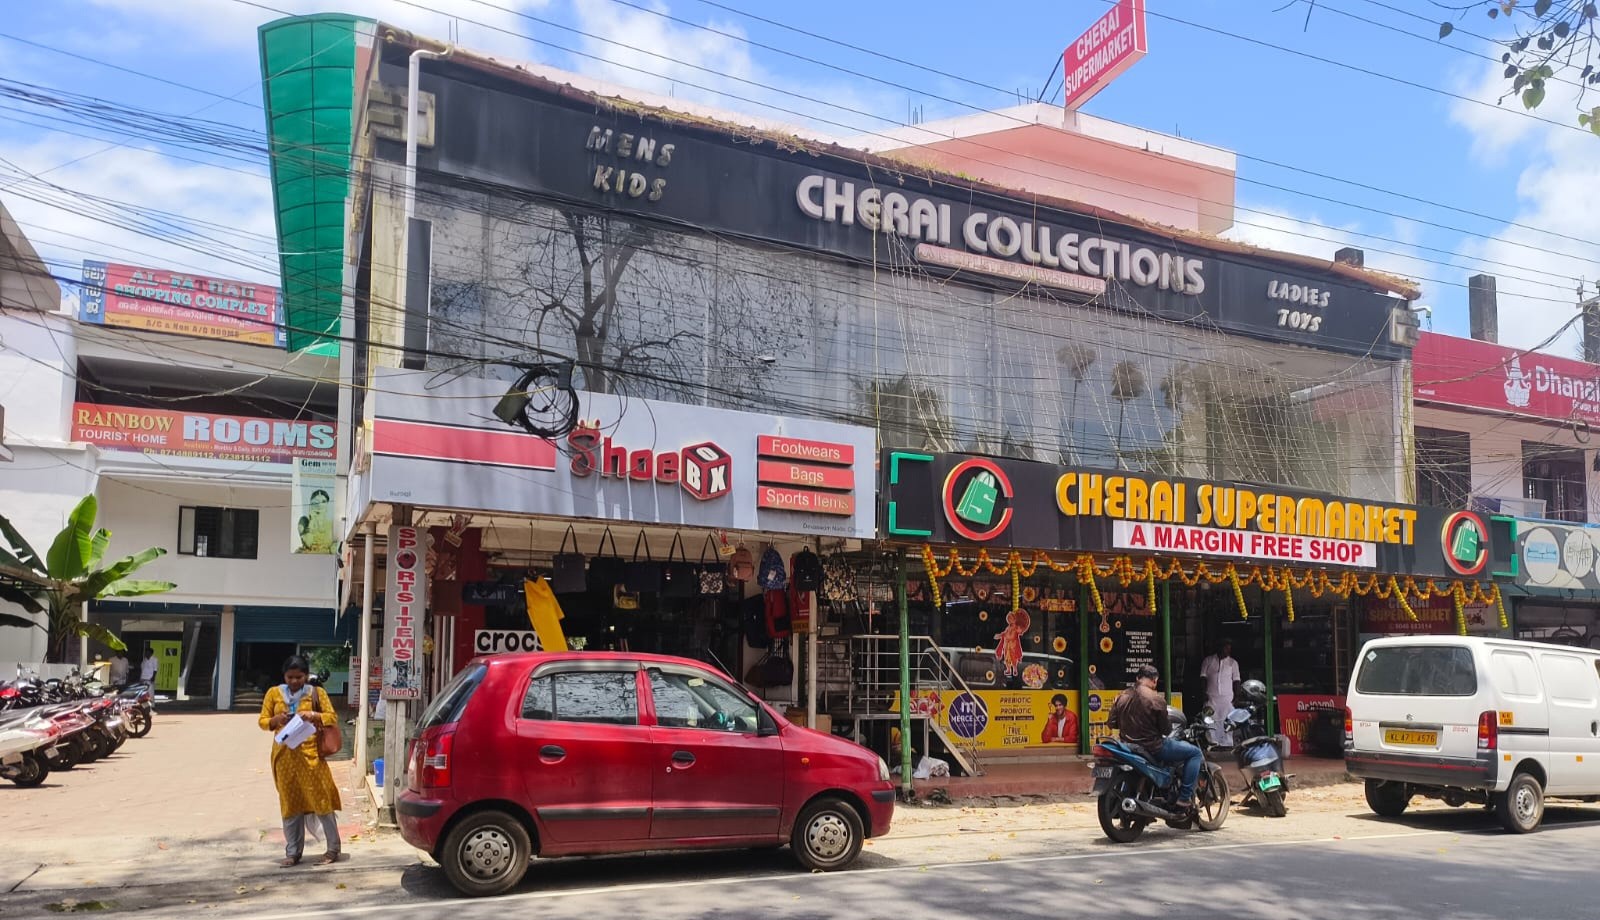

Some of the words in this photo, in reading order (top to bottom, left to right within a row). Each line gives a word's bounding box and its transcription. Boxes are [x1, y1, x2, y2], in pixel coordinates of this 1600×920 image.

[1076, 6, 1120, 60] CHERAI
[1066, 22, 1134, 97] SUPERMARKET
[585, 125, 676, 167] MENS
[592, 165, 667, 201] KIDS
[796, 174, 951, 245] CHERAI
[962, 211, 1206, 296] COLLECTIONS
[114, 284, 192, 307] SHOPPING
[195, 295, 268, 316] COMPLEX
[1267, 280, 1331, 307] LADIES
[1277, 308, 1322, 332] TOYS
[77, 409, 174, 432] RAINBOW
[79, 429, 129, 441] TOURIST
[133, 432, 167, 444] HOME
[183, 415, 335, 449] ROOMS
[772, 439, 841, 460] Footwears
[790, 466, 824, 483] Bags
[765, 488, 810, 507] Sports
[813, 492, 850, 511] Items
[1055, 472, 1186, 523] CHERAI
[1196, 484, 1417, 545] SUPERMARKET
[1130, 525, 1147, 546] A
[1154, 527, 1244, 554] MARGIN
[1251, 535, 1303, 559] FREE
[1309, 540, 1363, 563] SHOP
[392, 606, 415, 660] ITEMS
[1000, 707, 1031, 715] PROBIOTIC
[1390, 733, 1399, 742] KL
[1400, 734, 1409, 742] 47
[1417, 734, 1435, 743] 4576
